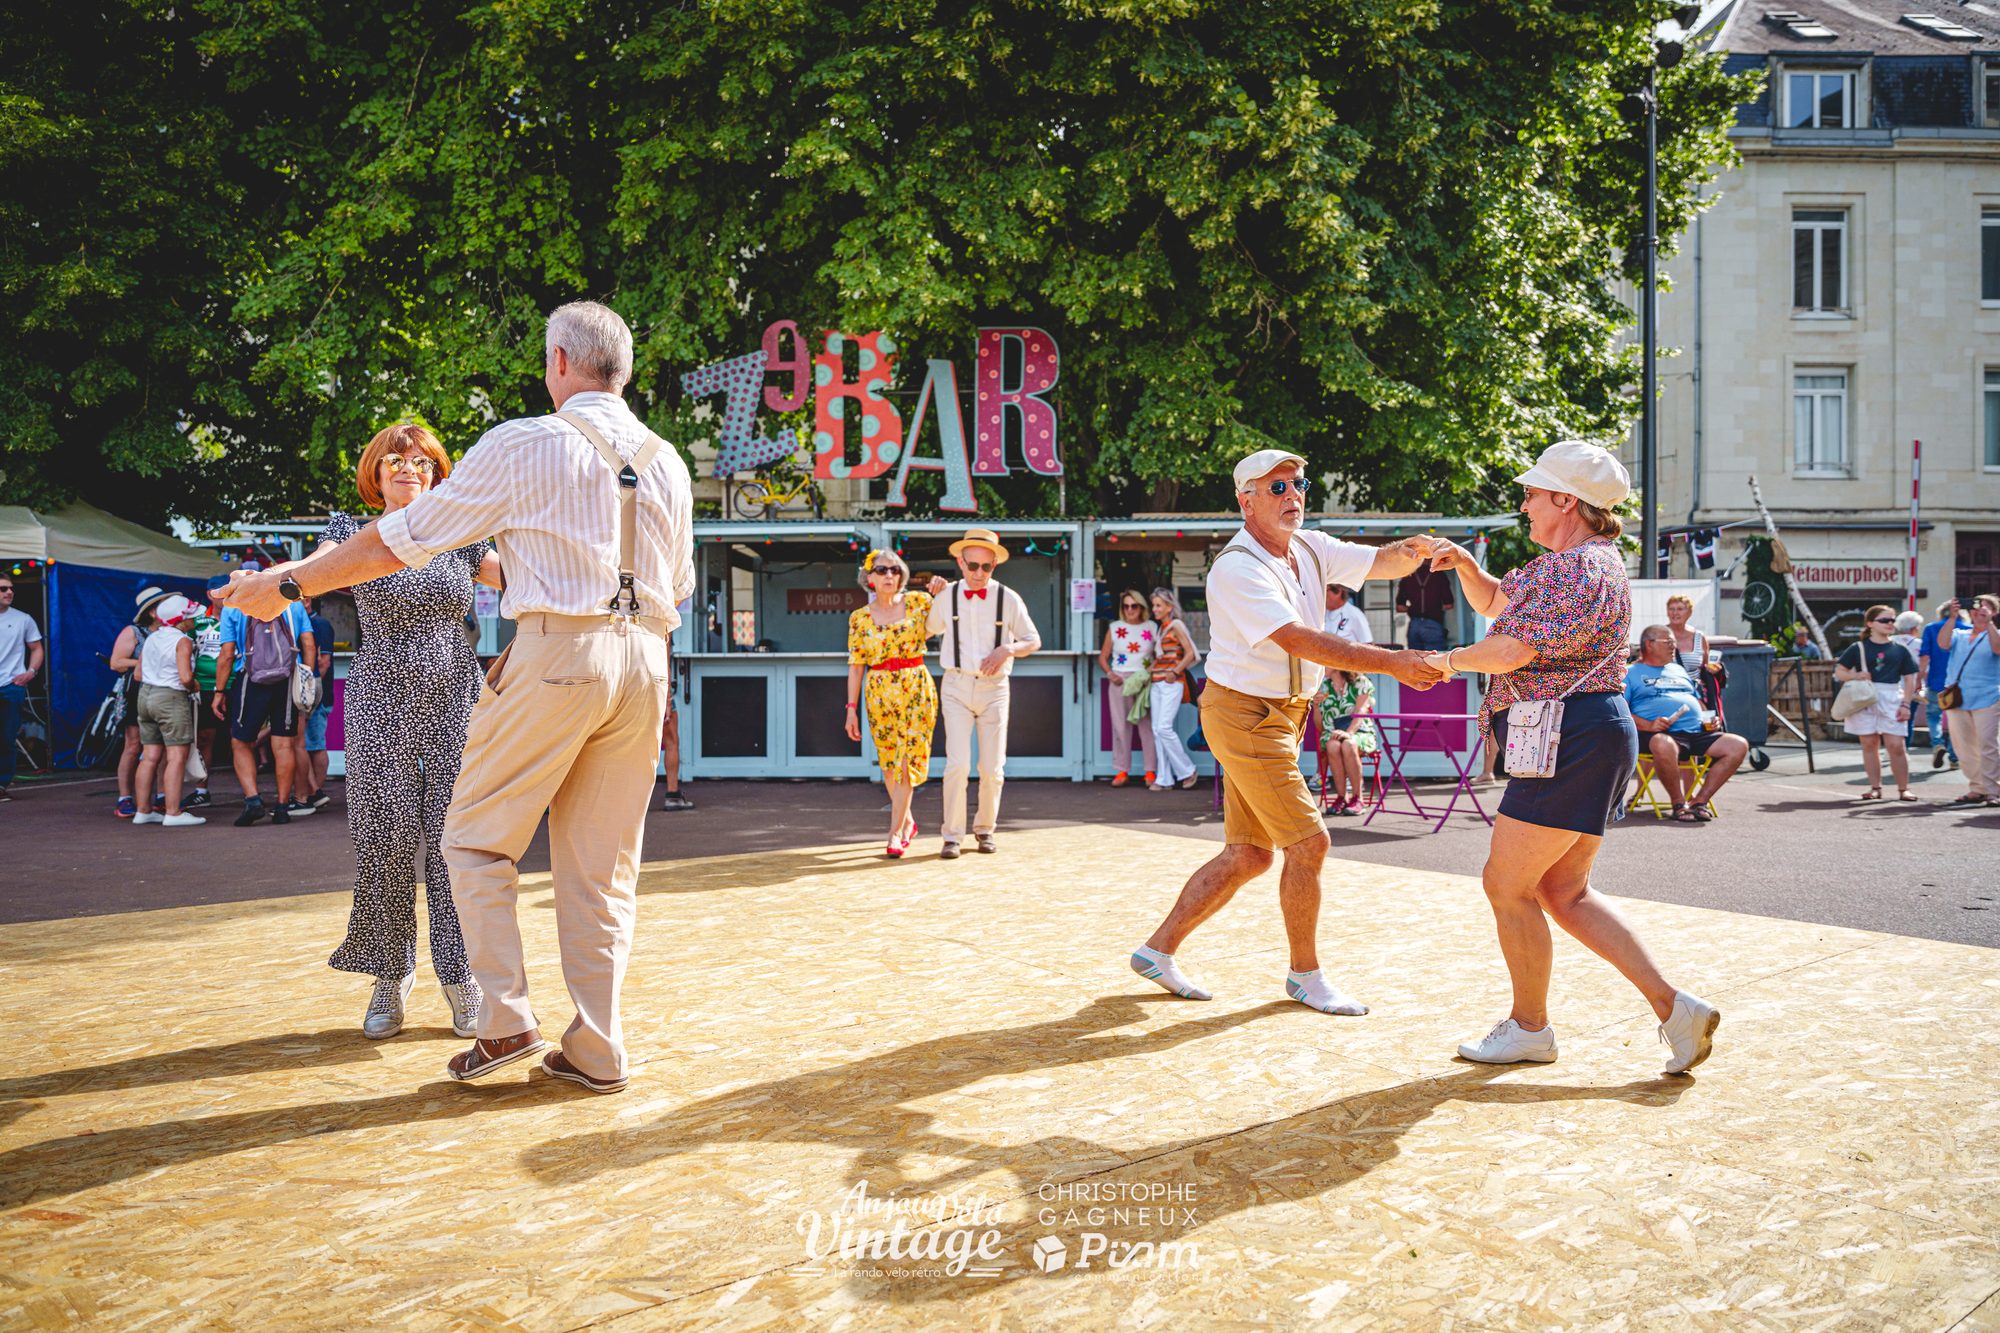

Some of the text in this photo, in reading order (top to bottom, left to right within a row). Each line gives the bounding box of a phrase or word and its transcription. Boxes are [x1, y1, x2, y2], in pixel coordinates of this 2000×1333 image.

[814, 326, 1064, 513] BAR
[805, 593, 854, 606] V AND B
